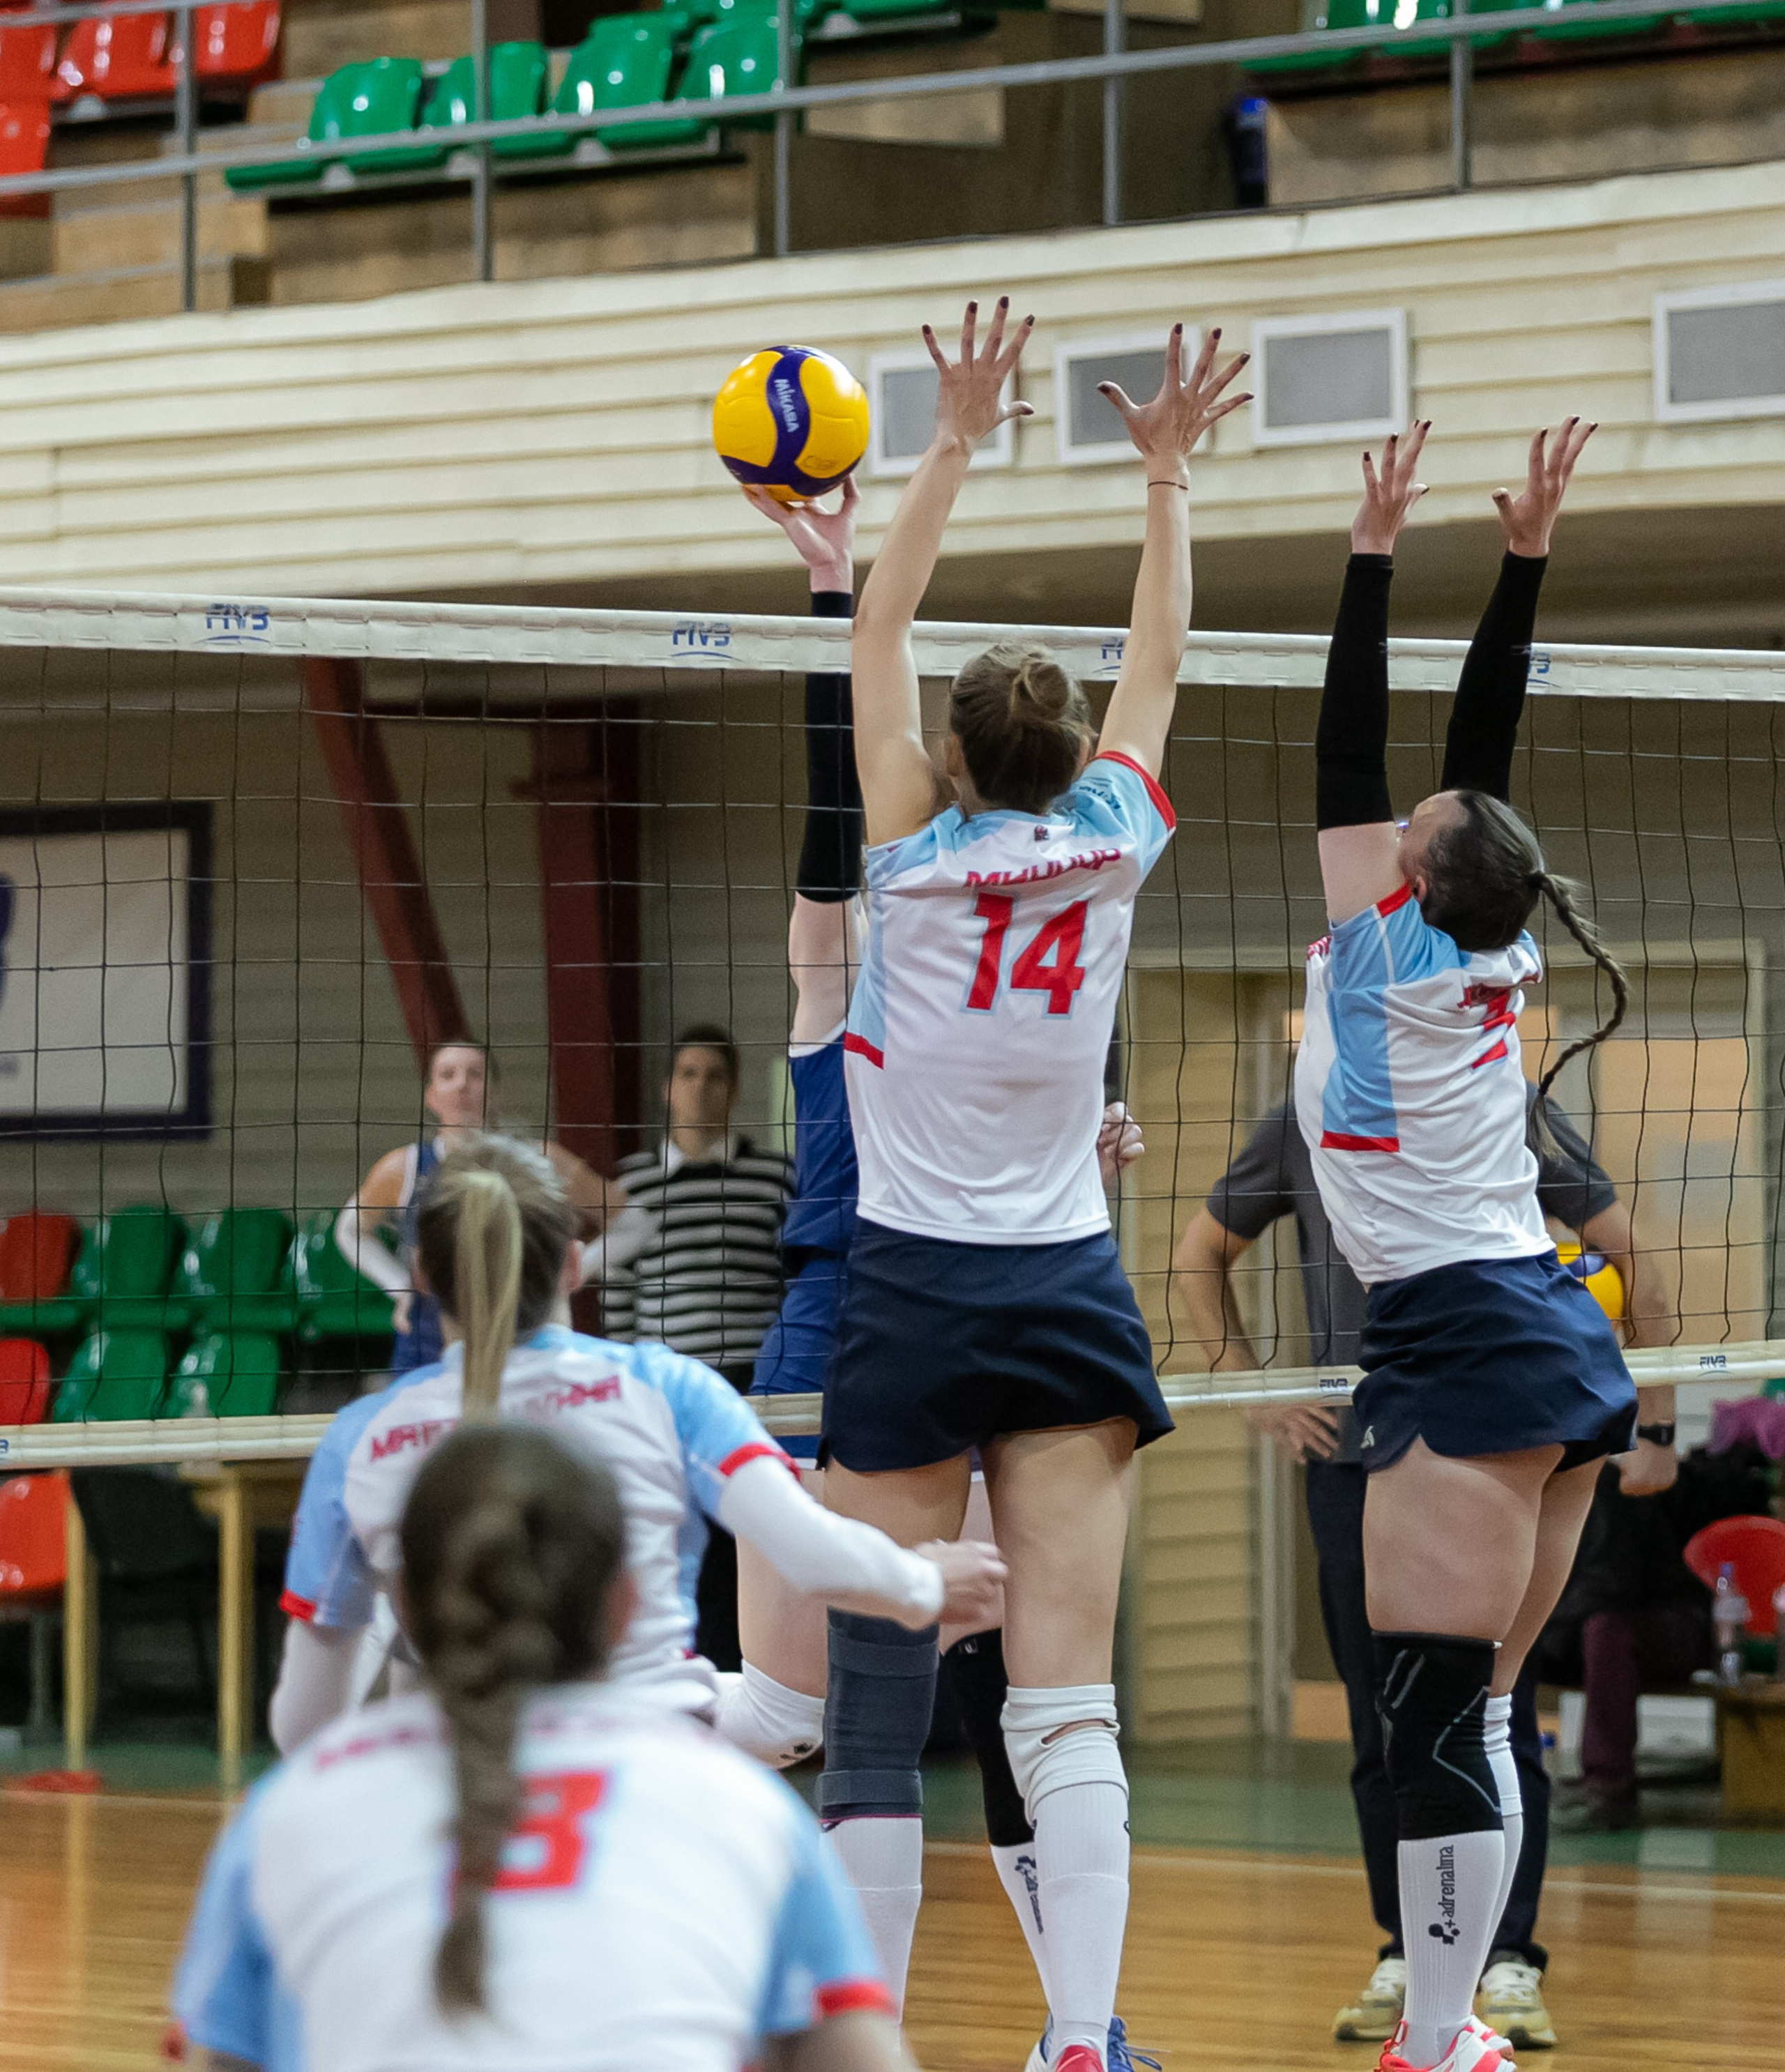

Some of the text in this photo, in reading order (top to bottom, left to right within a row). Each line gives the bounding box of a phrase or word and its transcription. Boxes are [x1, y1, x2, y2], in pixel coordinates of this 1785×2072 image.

[205, 603, 270, 630] FIVB
[672, 620, 731, 646] FIVB
[966, 892, 1090, 1015] 14
[1699, 1355, 1727, 1369] FIVB
[1319, 1378, 1348, 1391] FIVB
